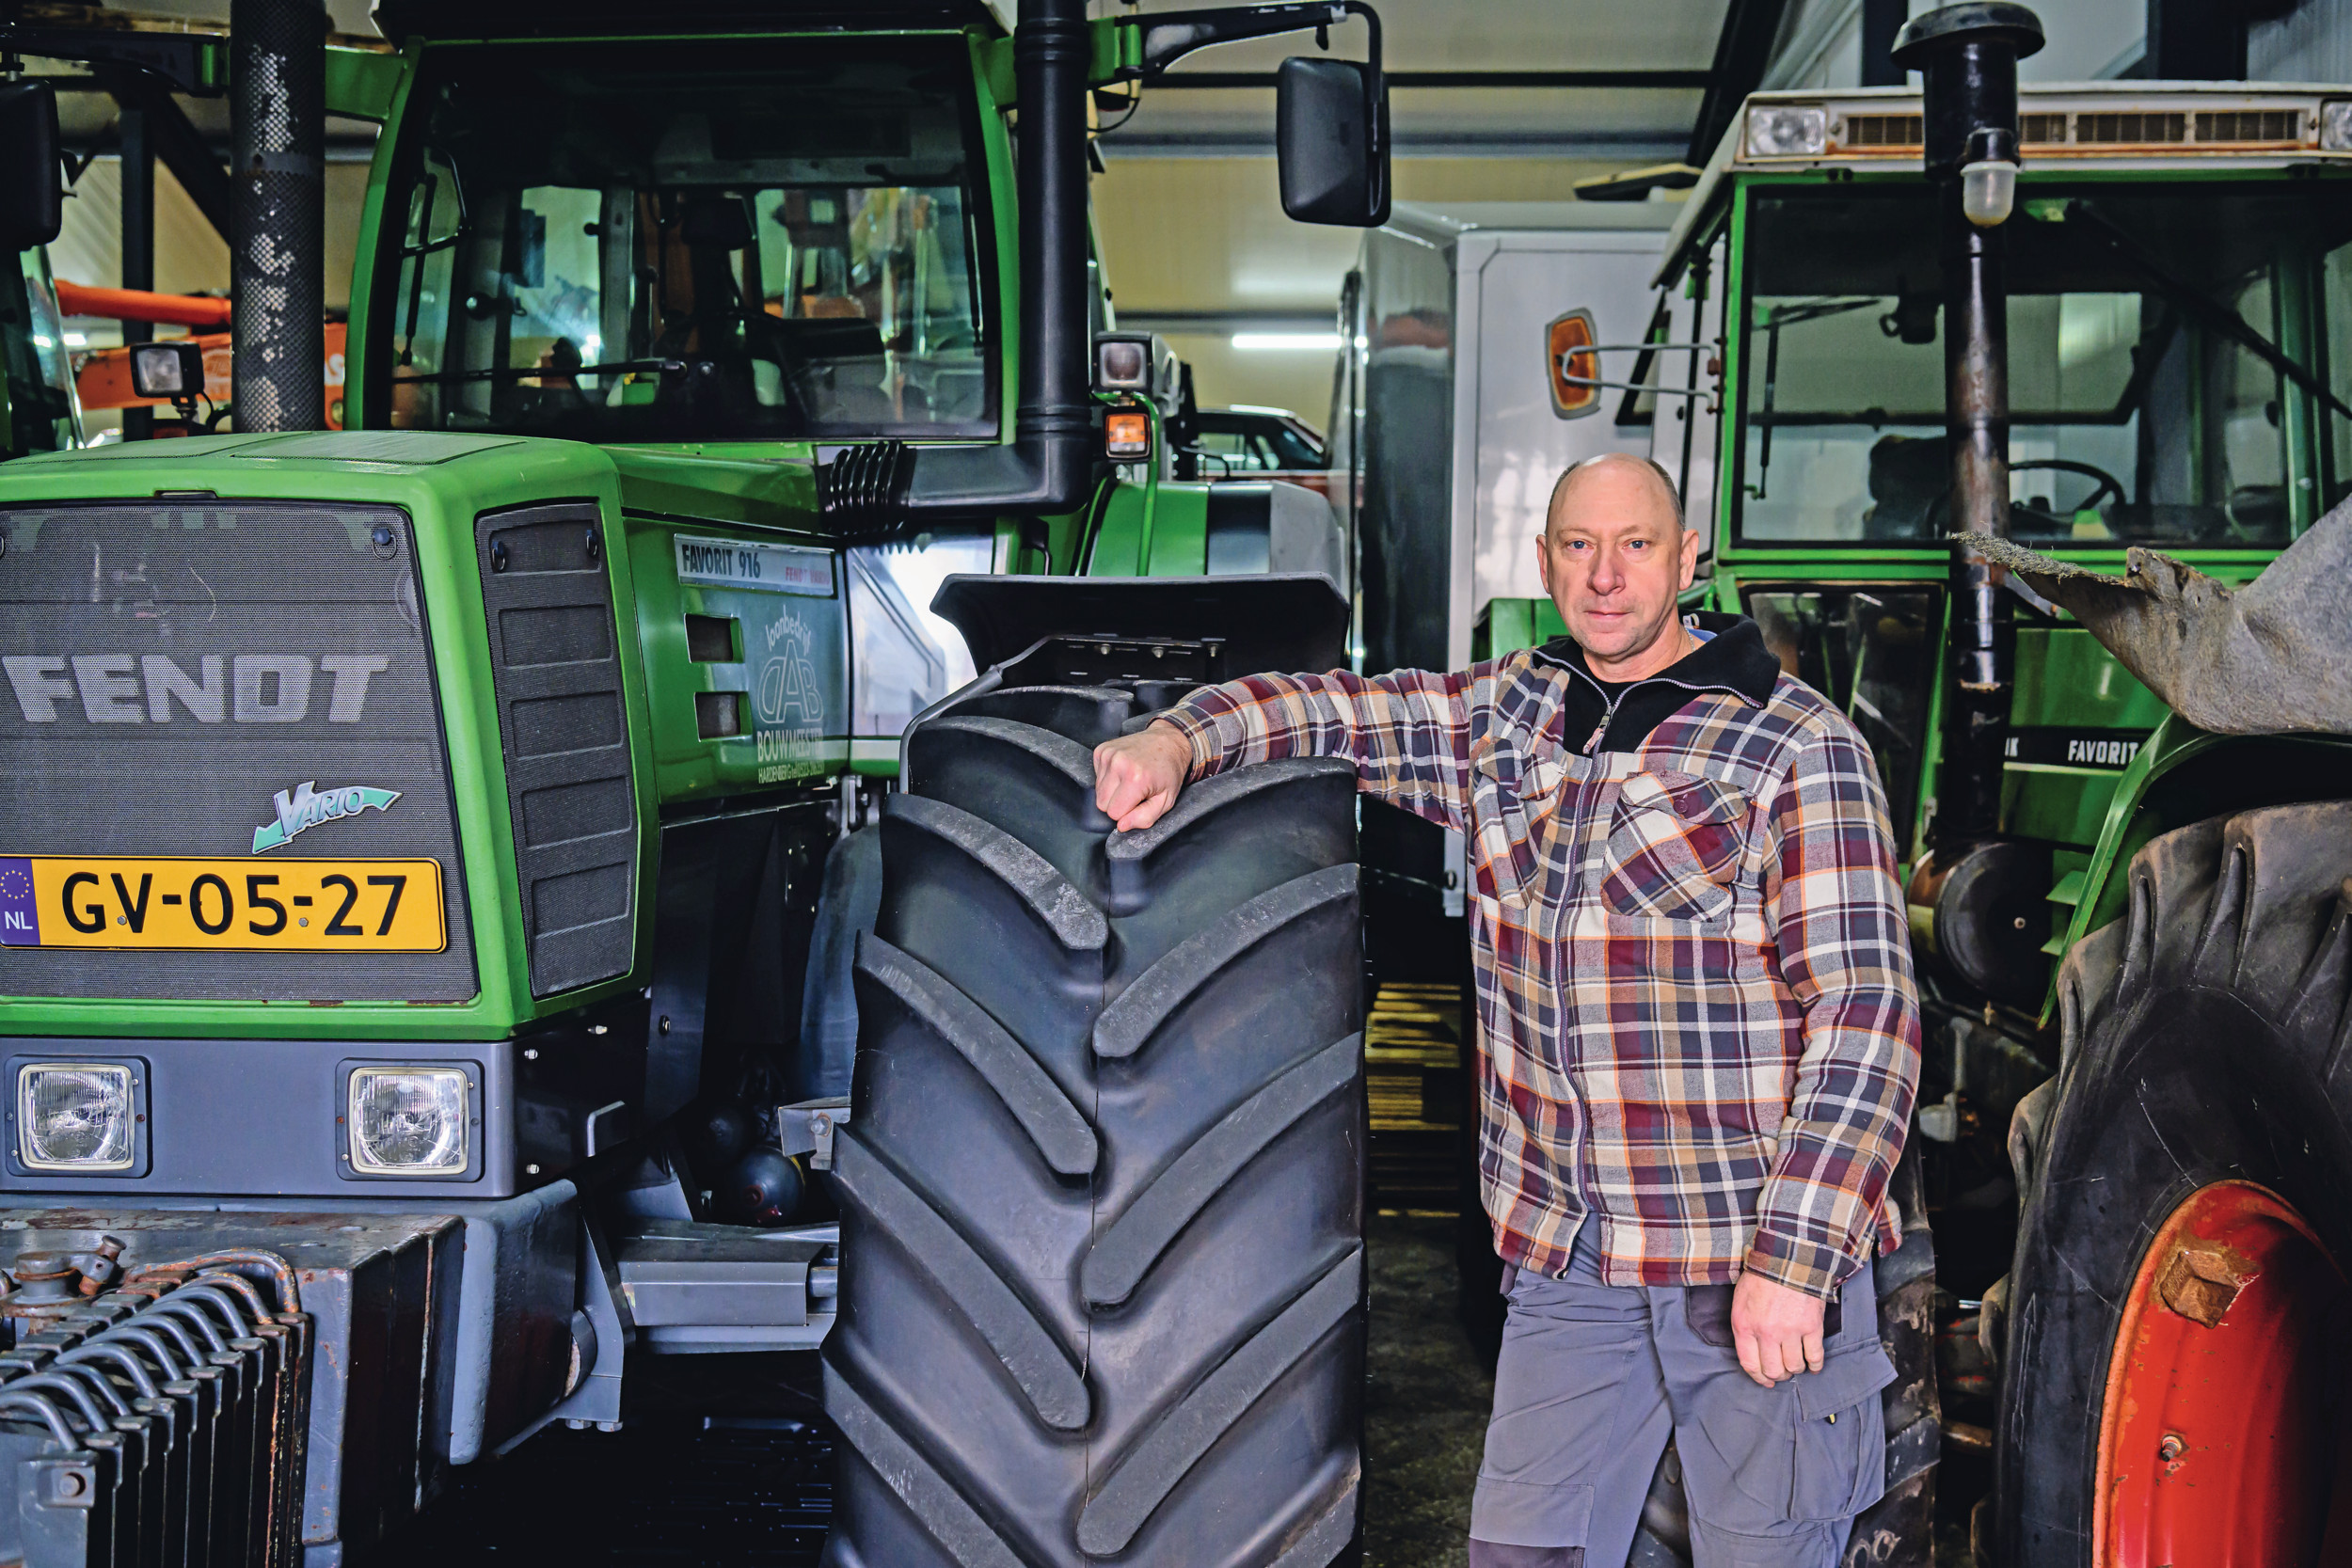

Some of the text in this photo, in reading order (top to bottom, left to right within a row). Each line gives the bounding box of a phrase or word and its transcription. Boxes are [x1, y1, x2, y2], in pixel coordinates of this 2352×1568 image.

[682, 544, 761, 578] FAVORIT 916
[765, 604, 812, 657] loonbedrijf
[2, 655, 390, 722] FENDT
[2067, 739, 2139, 765] FAVORIT
[5, 911, 34, 930] NL
[61, 871, 407, 936] GV-05-27
